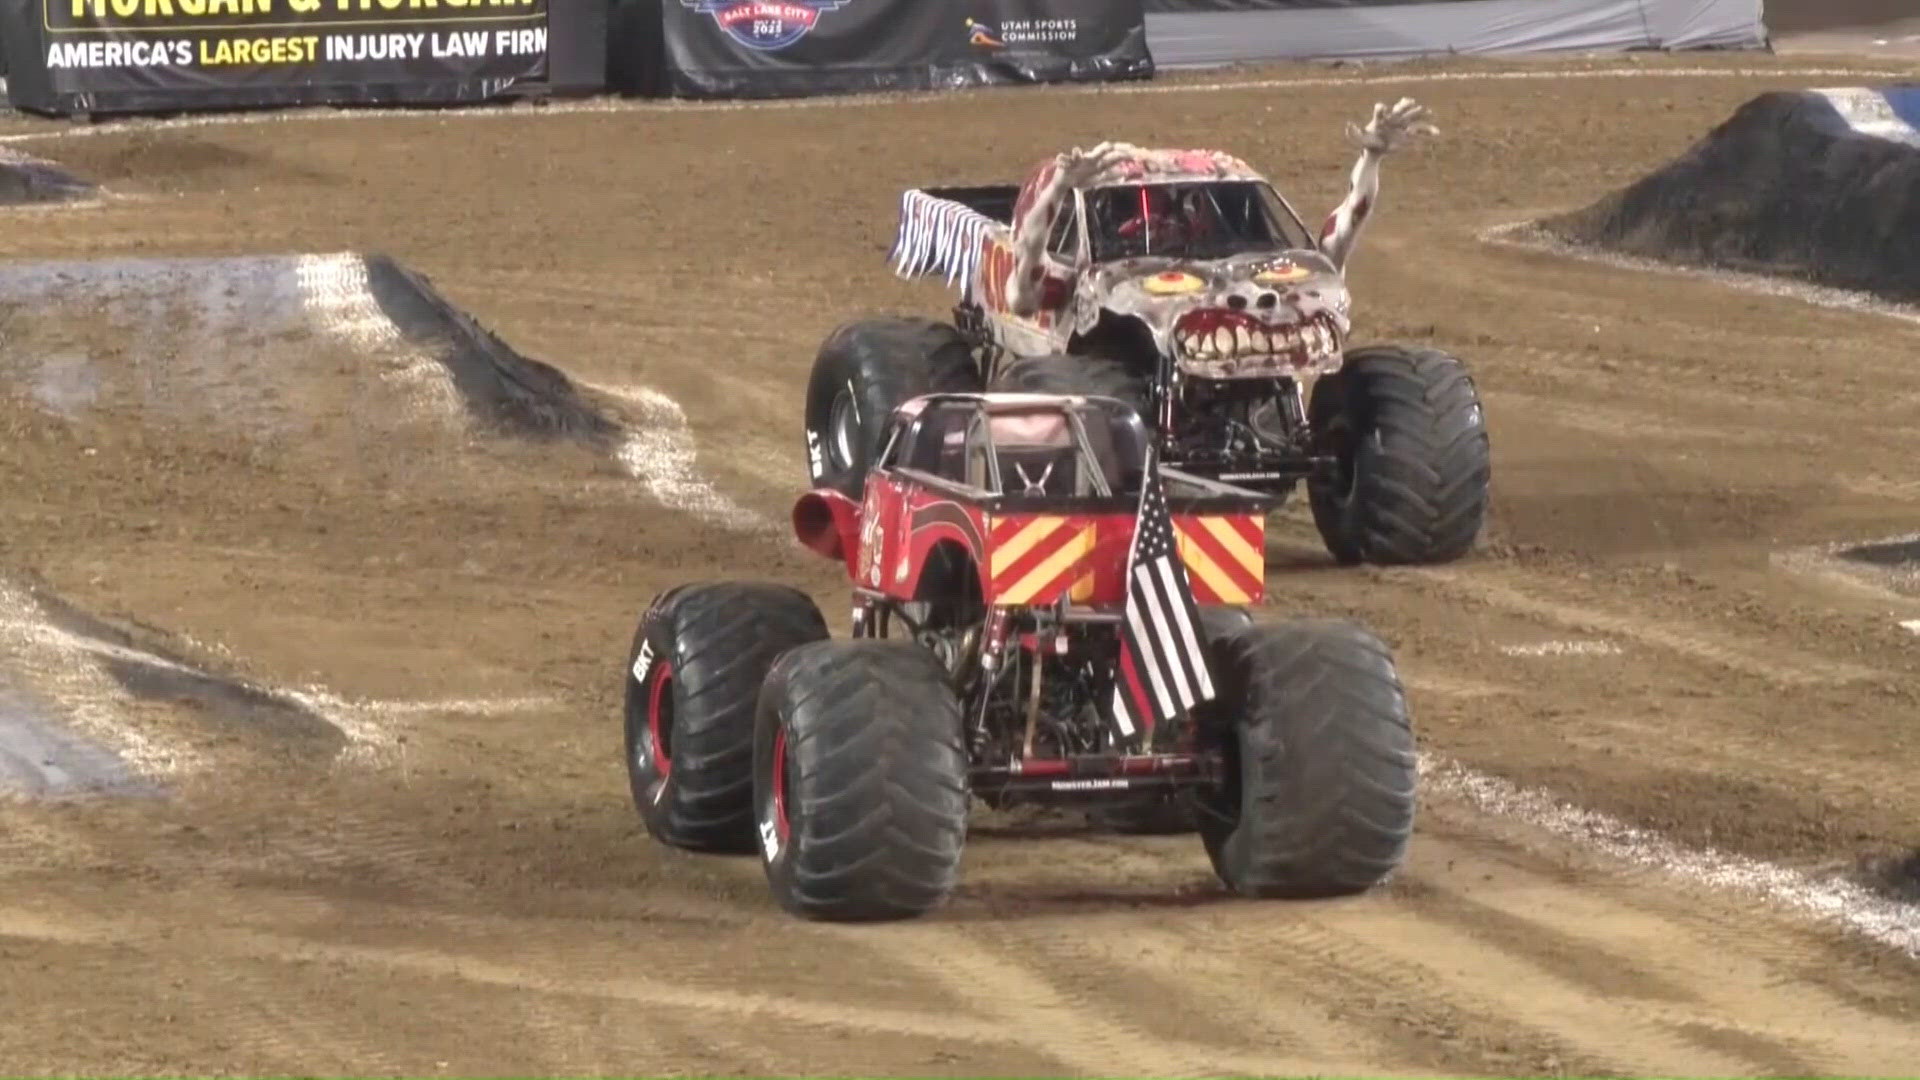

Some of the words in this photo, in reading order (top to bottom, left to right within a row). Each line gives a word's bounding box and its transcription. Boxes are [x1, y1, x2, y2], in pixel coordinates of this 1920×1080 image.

[724, 7, 750, 20] SALT
[784, 6, 809, 19] CITY
[1001, 21, 1030, 31] UTAH
[1034, 20, 1077, 30] SPORTS
[1001, 31, 1077, 41] COMMISSION
[47, 40, 193, 68] AMERICA'S
[200, 36, 319, 65] LARGEST
[326, 33, 425, 61] INJURY
[431, 31, 489, 57] LAW
[807, 429, 823, 478] BKT
[633, 638, 654, 683] BKT
